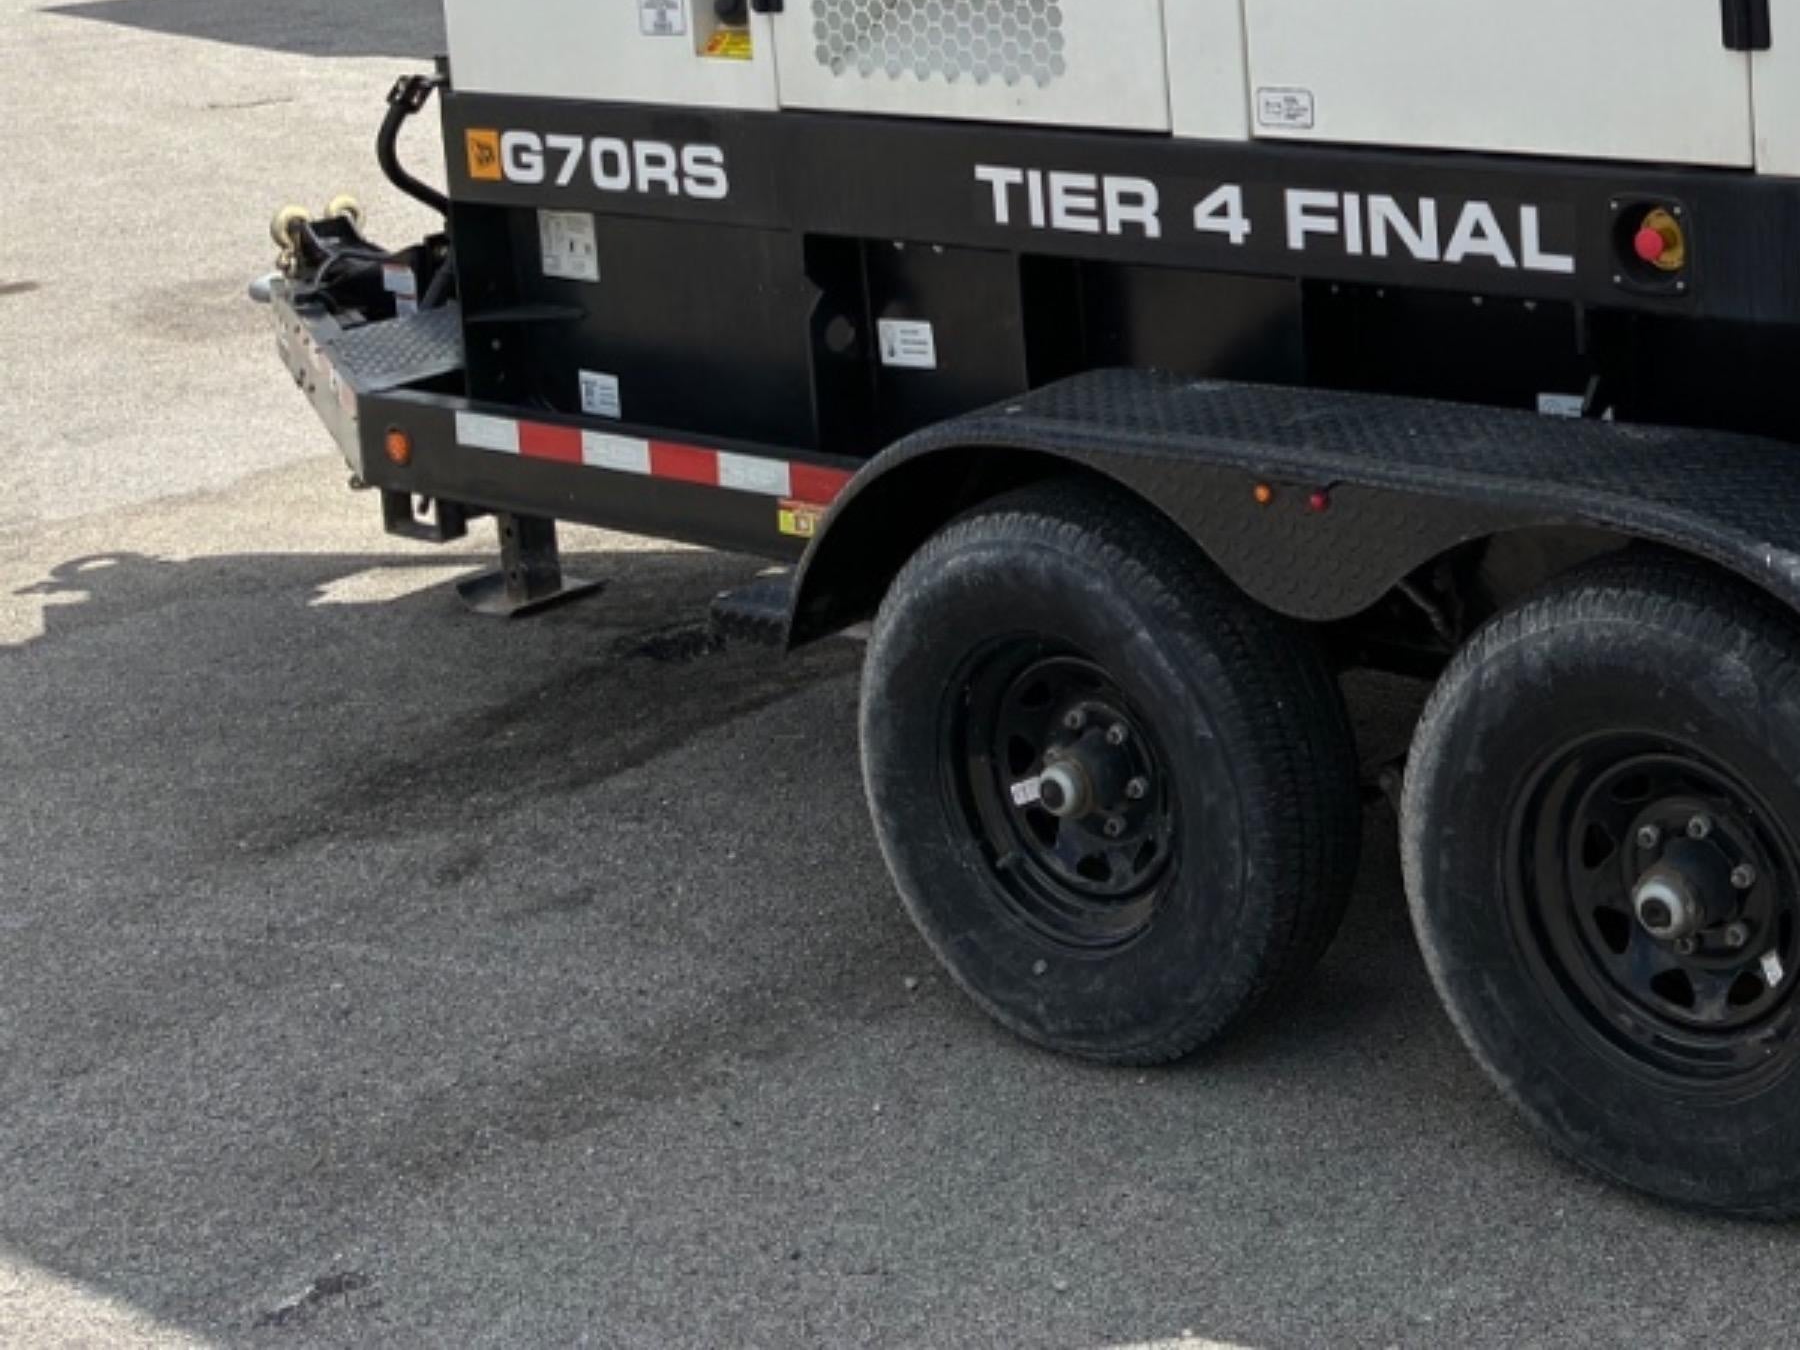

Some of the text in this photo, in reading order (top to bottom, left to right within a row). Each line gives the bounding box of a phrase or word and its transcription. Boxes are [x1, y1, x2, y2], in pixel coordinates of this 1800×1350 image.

[500, 131, 728, 198] G70RS
[975, 165, 1573, 272] TIER 4 FINAL
